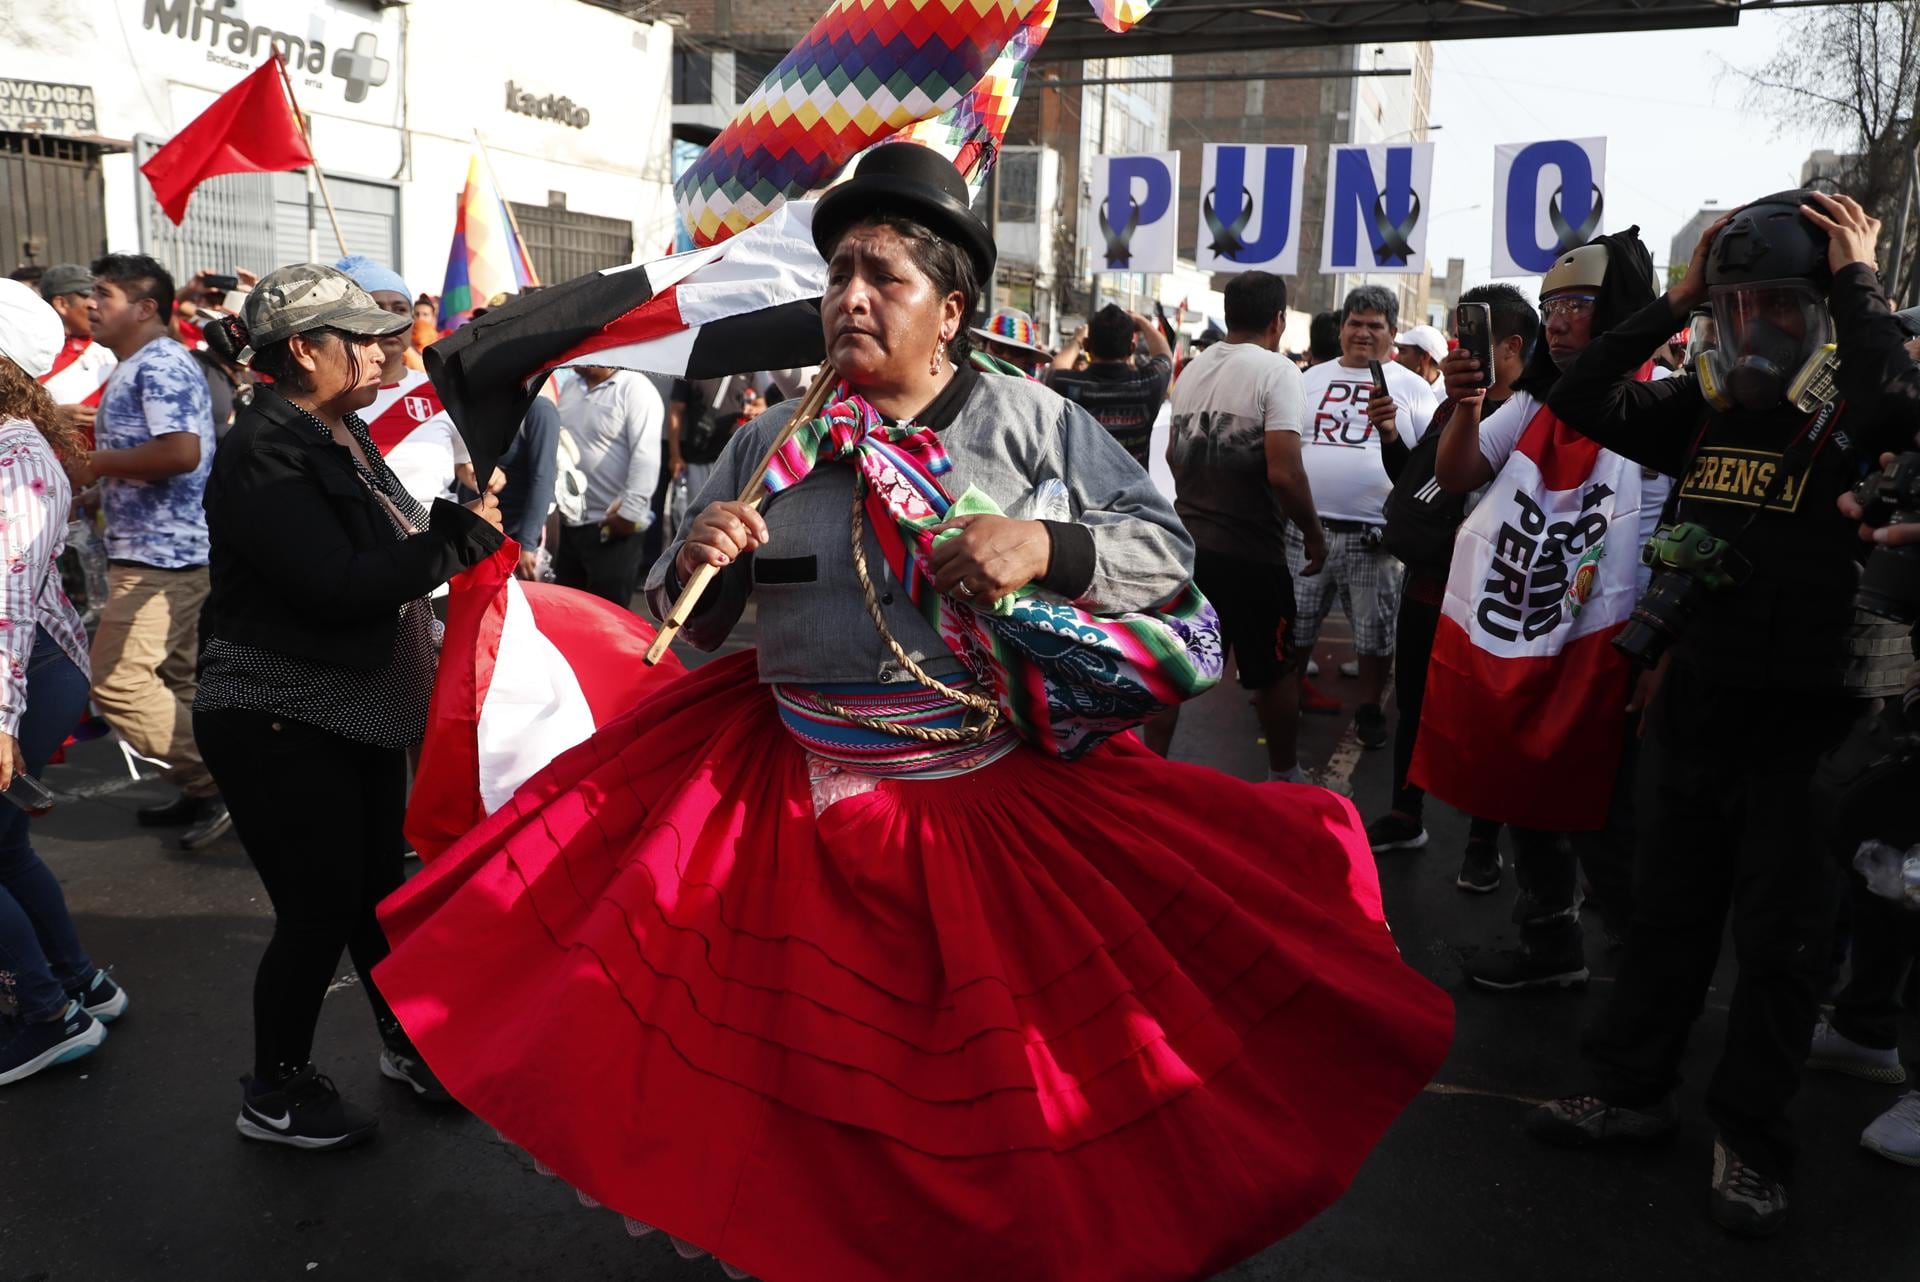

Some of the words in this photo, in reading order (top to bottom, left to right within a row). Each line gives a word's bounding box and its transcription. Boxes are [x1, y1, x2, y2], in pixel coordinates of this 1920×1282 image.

[142, 0, 325, 74] Mifarma
[0, 98, 94, 121] CALZADOS
[1808, 400, 1835, 441] Canon
[1477, 489, 1547, 642] PERU
